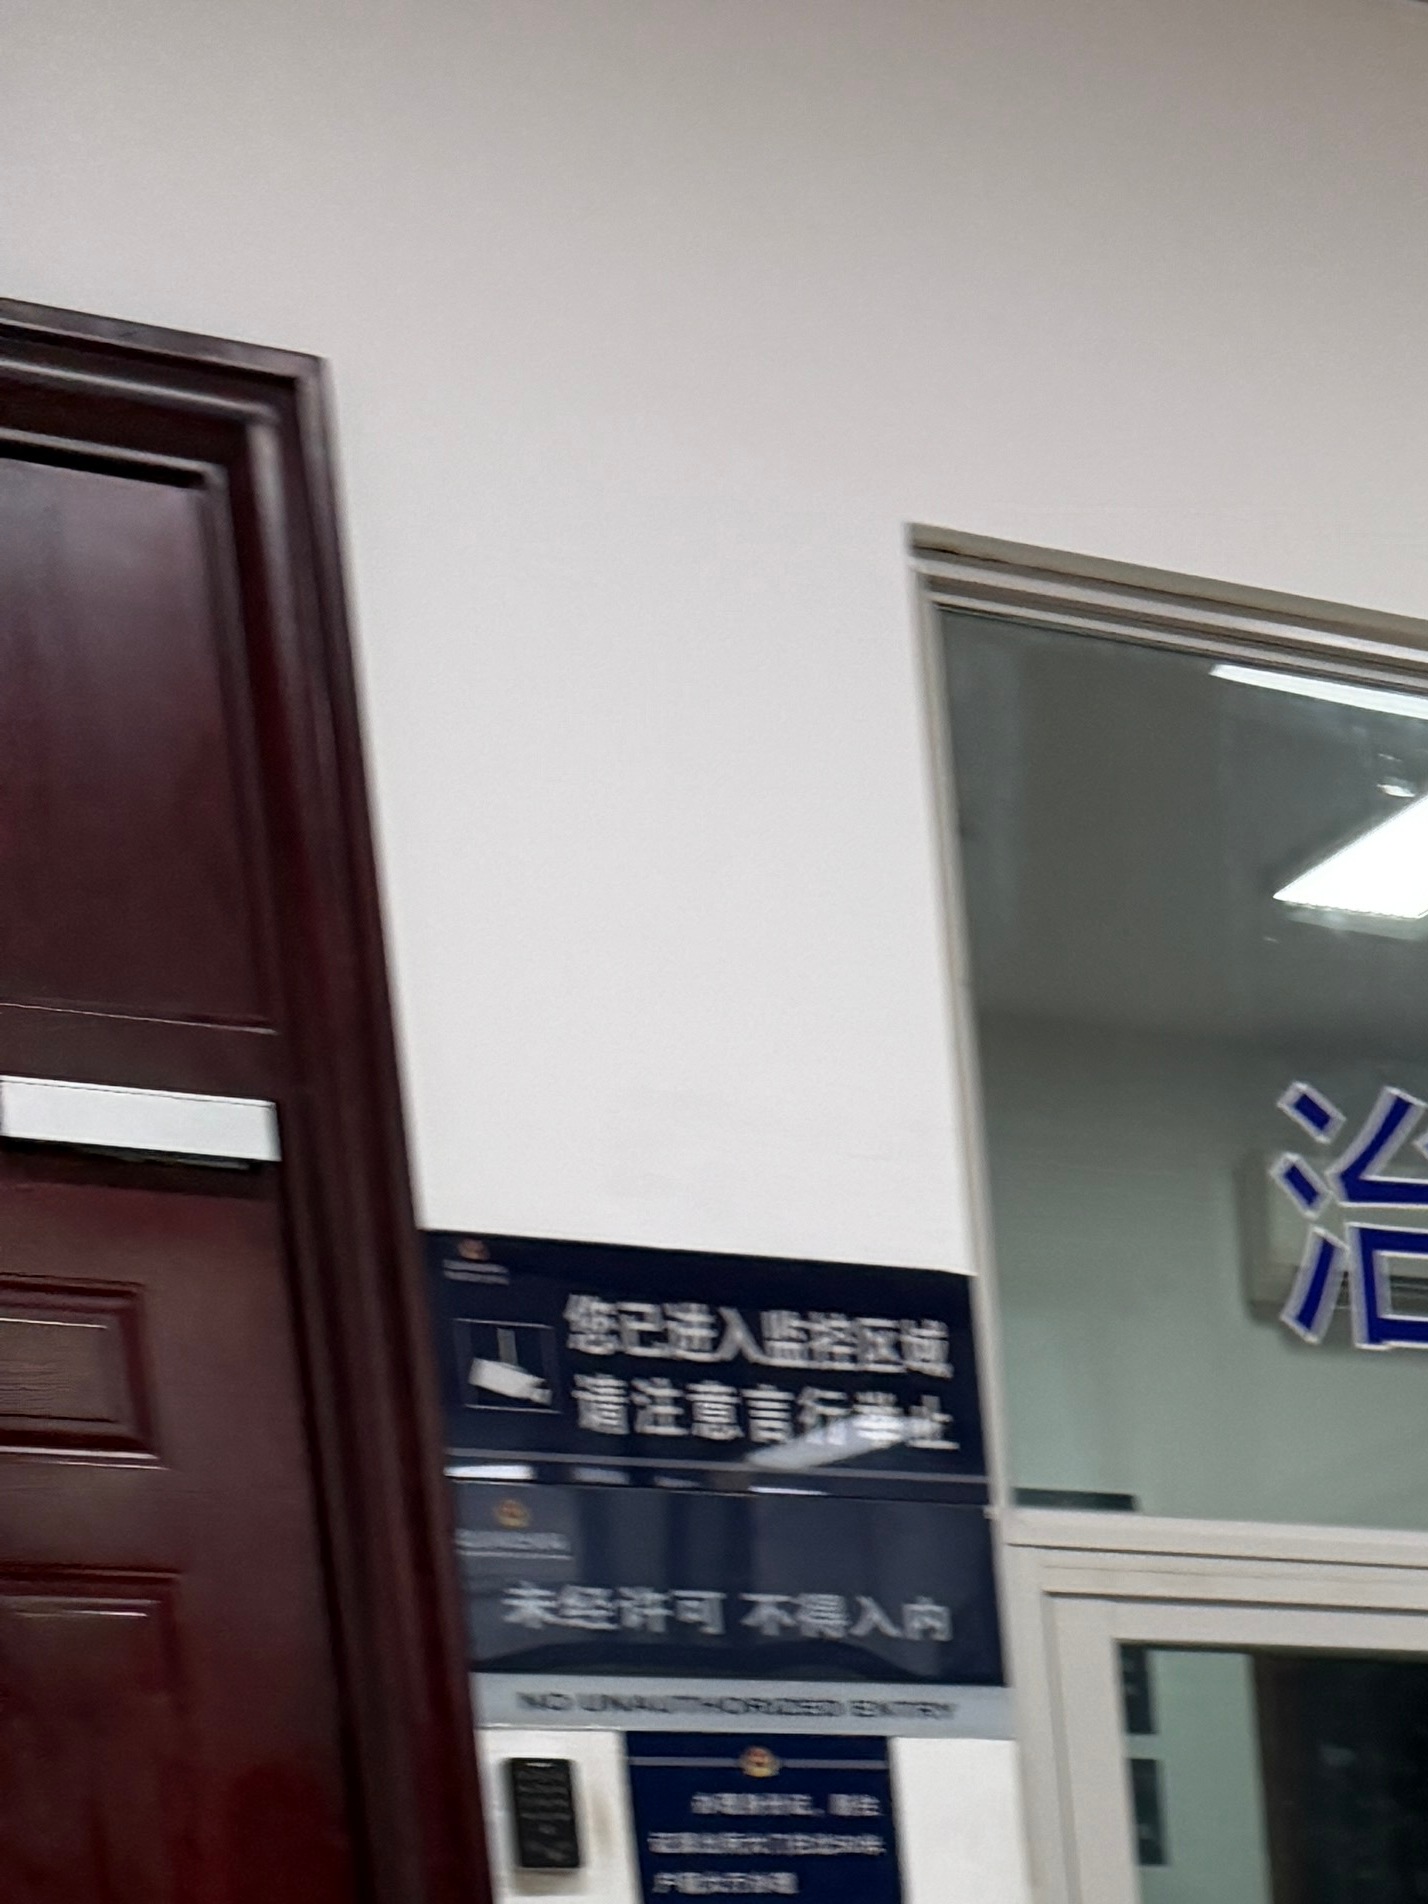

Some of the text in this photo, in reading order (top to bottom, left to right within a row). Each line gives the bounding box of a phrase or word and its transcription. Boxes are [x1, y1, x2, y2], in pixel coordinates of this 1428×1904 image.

[562, 1292, 954, 1380] 您已进入监控区域
[502, 1582, 953, 1643] 未经许可 不得入内
[515, 1690, 573, 1712] NO
[851, 1700, 957, 1721] ENTRY
